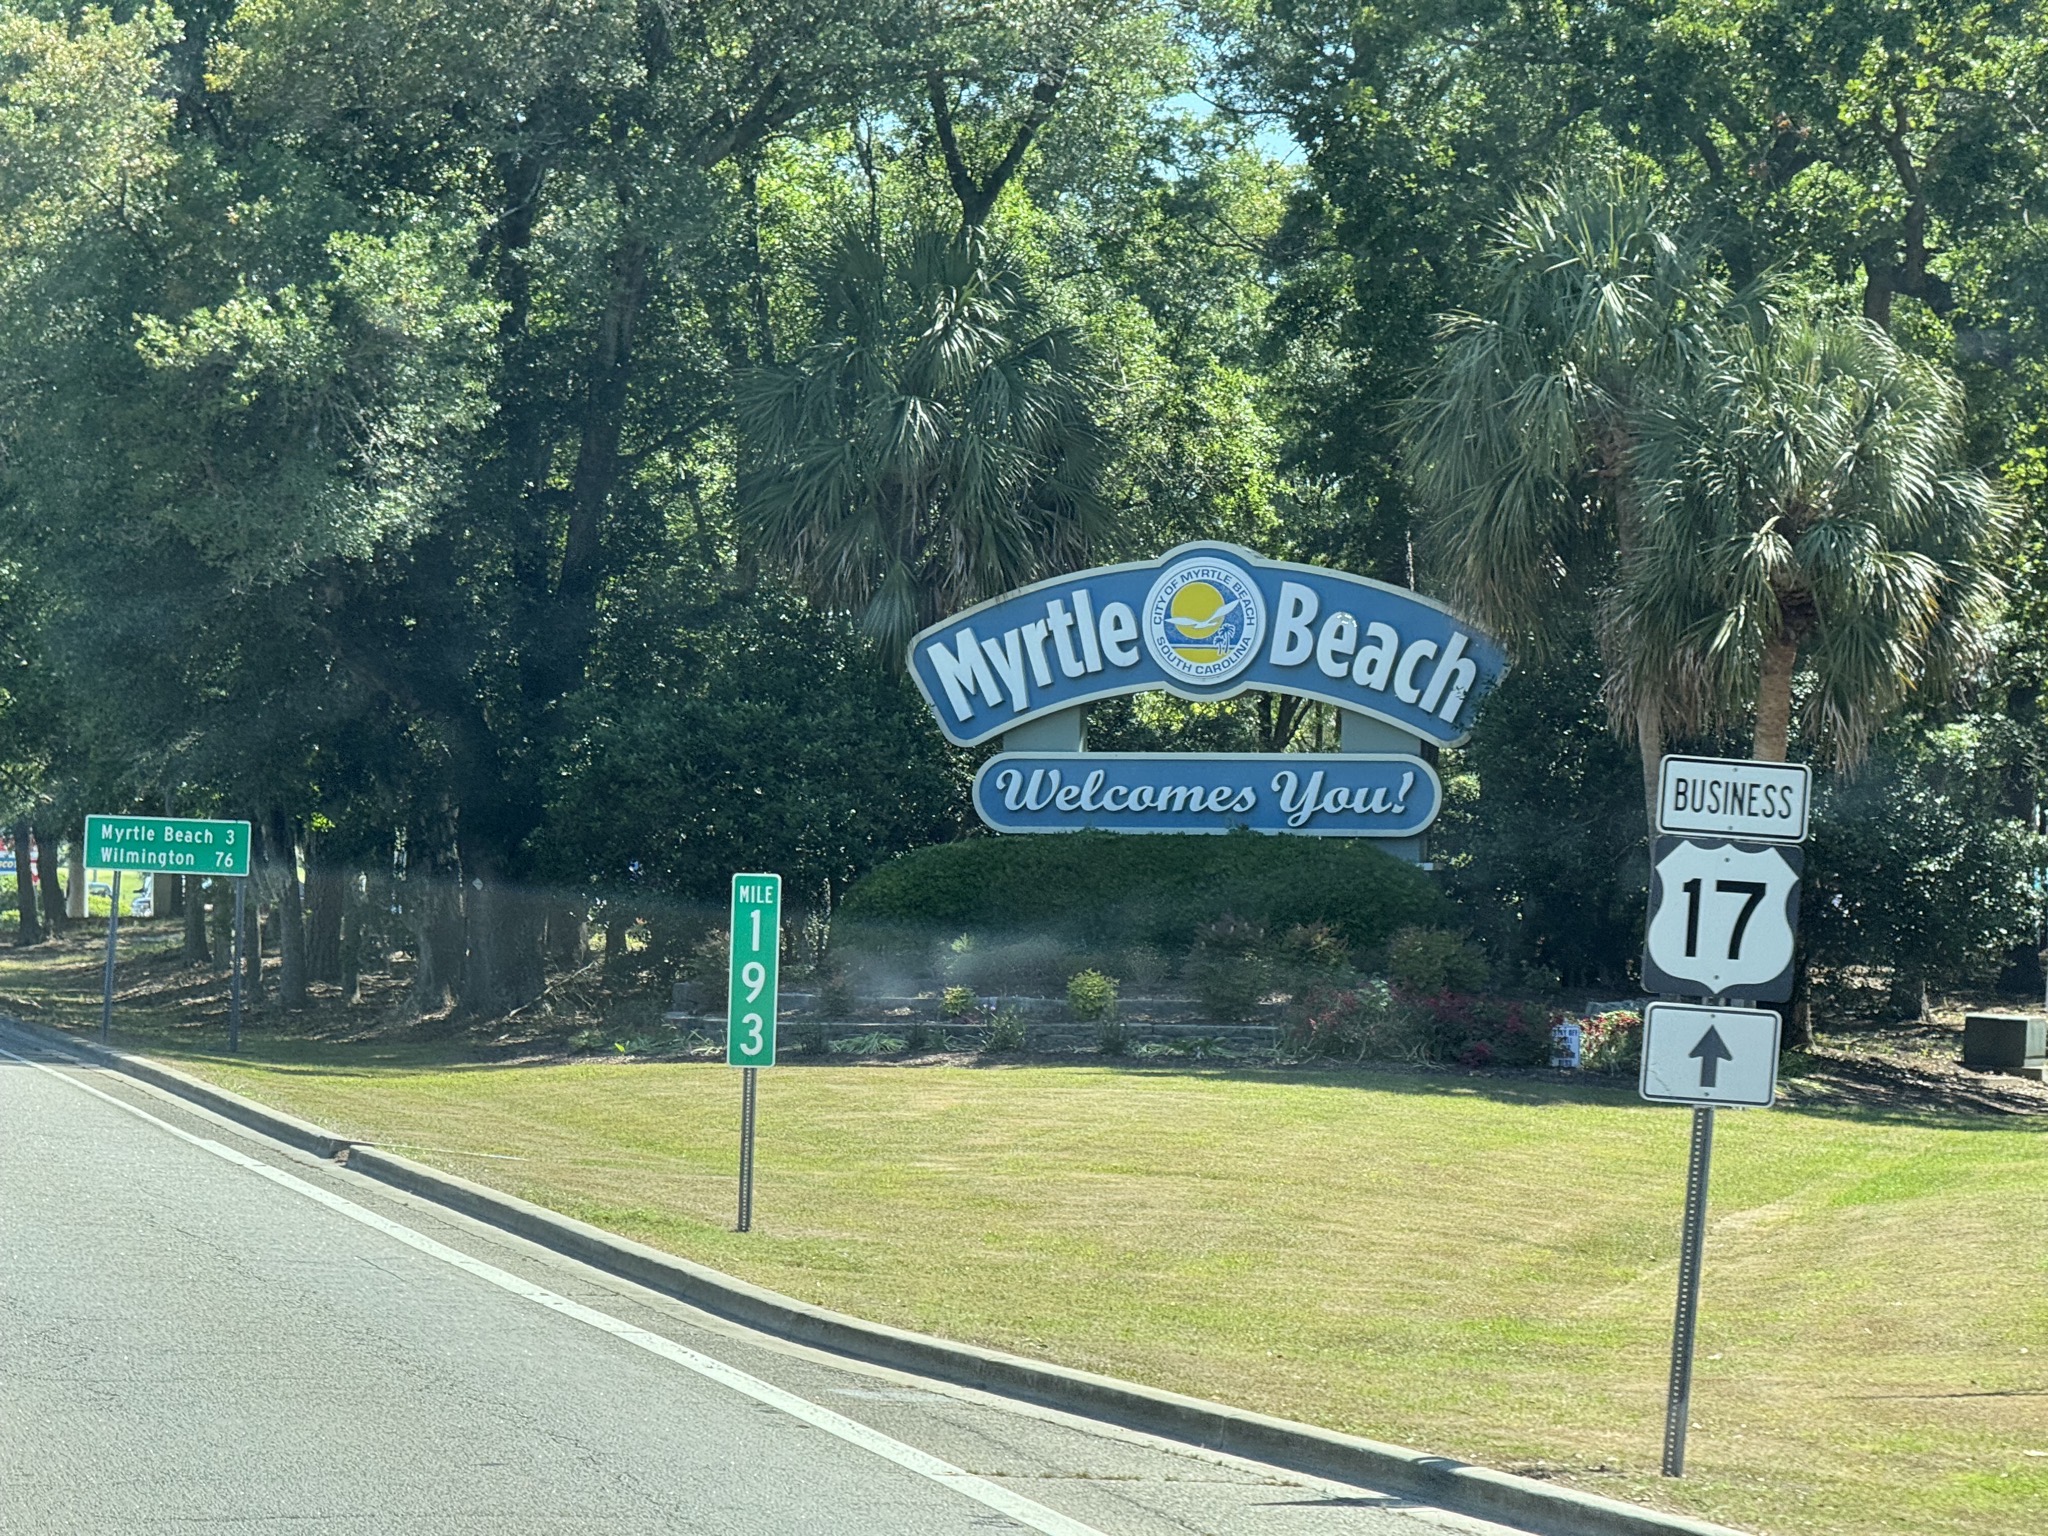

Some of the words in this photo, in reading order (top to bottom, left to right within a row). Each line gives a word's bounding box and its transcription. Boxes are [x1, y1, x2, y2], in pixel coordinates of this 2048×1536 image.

[1153, 598, 1167, 625] CITY
[1164, 579, 1182, 596] OF
[1180, 568, 1233, 585] MYRTLE
[1232, 582, 1255, 626] BEACH
[927, 589, 1140, 722] Myrtle
[1269, 581, 1477, 723] Beach
[1156, 636, 1192, 673] SOUTH
[1195, 637, 1252, 675] CAROLINA
[996, 768, 1257, 814] Welcomes
[1270, 769, 1417, 827] You!
[1674, 778, 1794, 819] BUSINESS
[101, 823, 155, 843] Myrtle
[164, 826, 213, 844] Beach
[225, 829, 235, 845] 3
[101, 847, 195, 868] Wilmington
[215, 851, 234, 868] 76
[739, 885, 774, 904] MILE
[1682, 878, 1767, 960] 17
[739, 909, 766, 1056] 193
